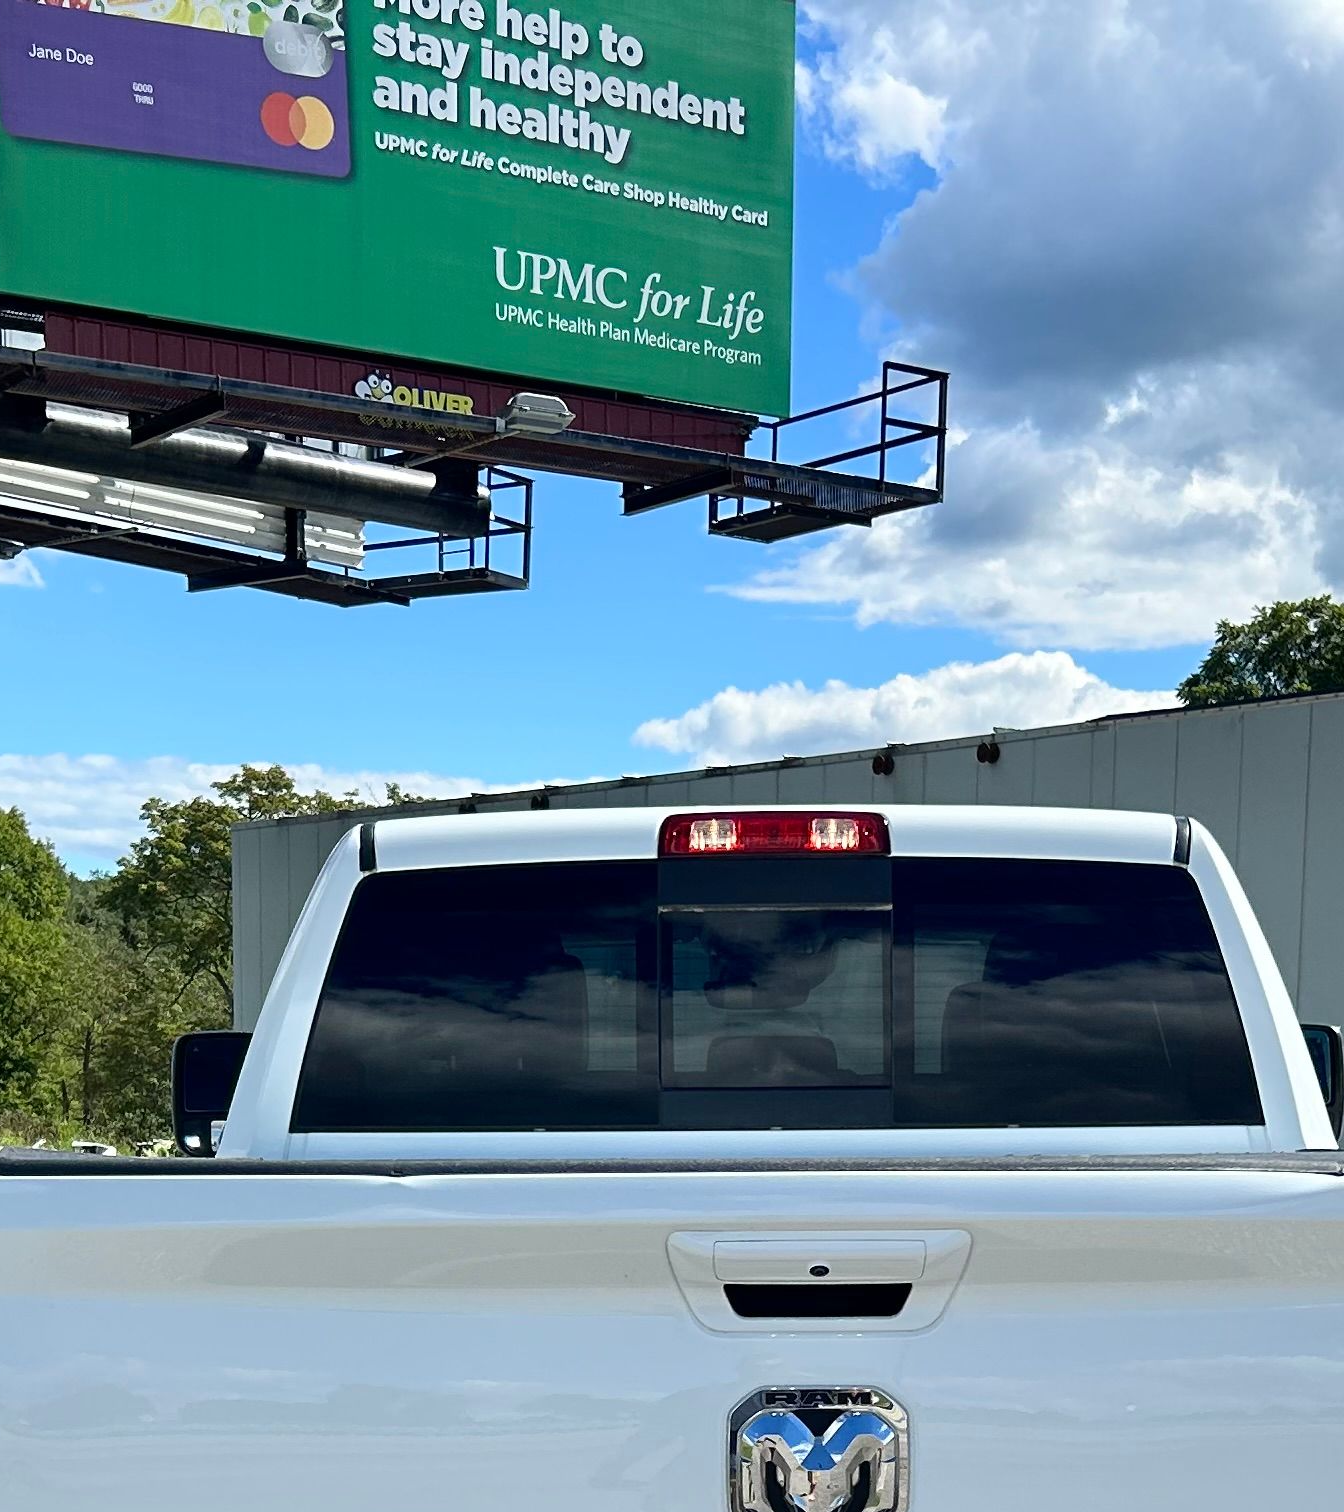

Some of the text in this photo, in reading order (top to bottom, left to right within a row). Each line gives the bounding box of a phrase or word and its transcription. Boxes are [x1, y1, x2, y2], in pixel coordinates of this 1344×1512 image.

[28, 44, 94, 66] Jane Doe
[274, 39, 322, 60] debit
[373, 0, 644, 68] ore help to
[373, 22, 745, 135] stay independent
[372, 75, 632, 164] and healthy
[374, 131, 768, 227] UPMC for Life Complete Care Shop Healthy Card
[493, 246, 765, 340] UPMC for Life
[495, 302, 762, 365] UPMC Health Plan Medicare Program
[393, 385, 474, 415] OLIVER
[764, 1391, 873, 1407] RAM
